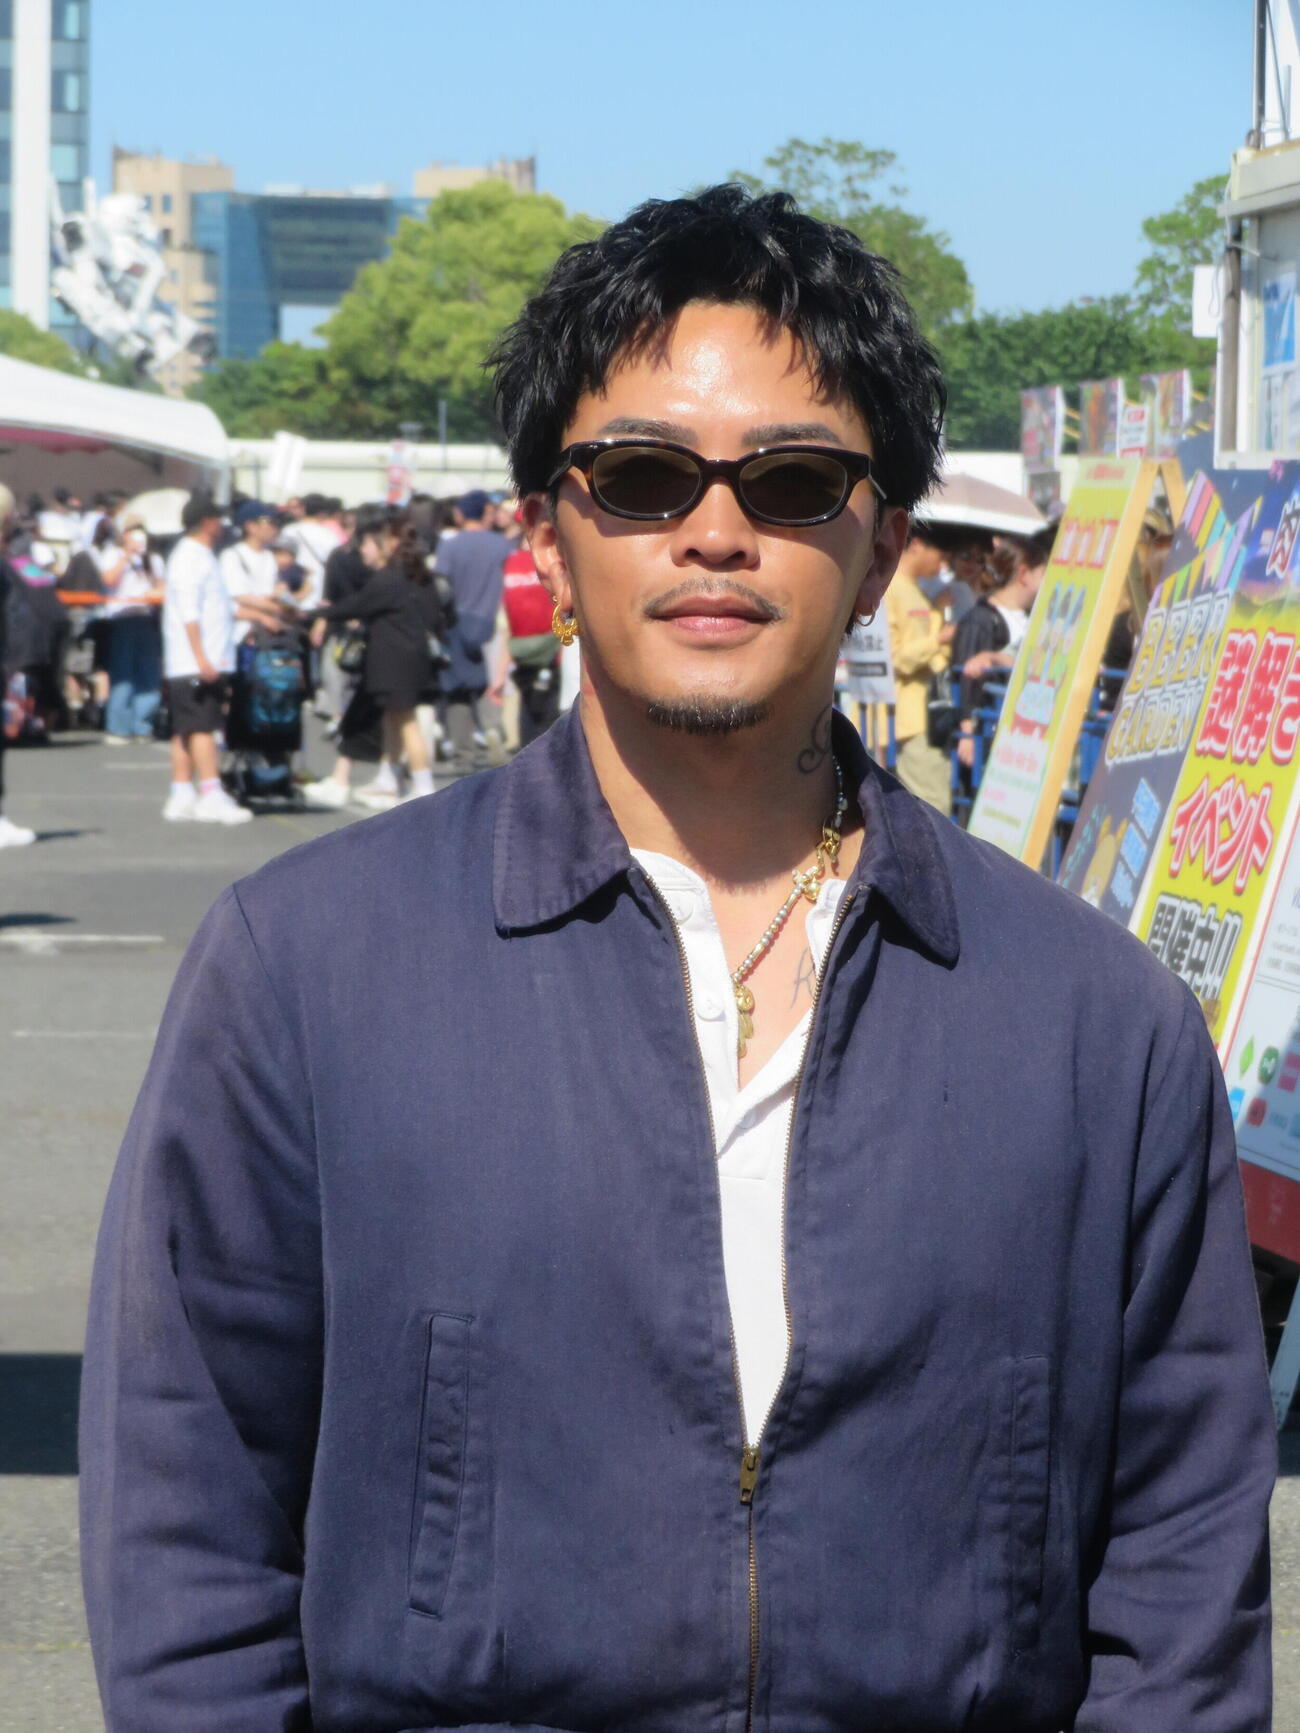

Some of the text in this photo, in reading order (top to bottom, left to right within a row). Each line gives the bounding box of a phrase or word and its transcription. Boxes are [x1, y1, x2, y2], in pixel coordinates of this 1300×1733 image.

[1123, 588, 1232, 698] BEER
[1170, 773, 1273, 896] イベント
